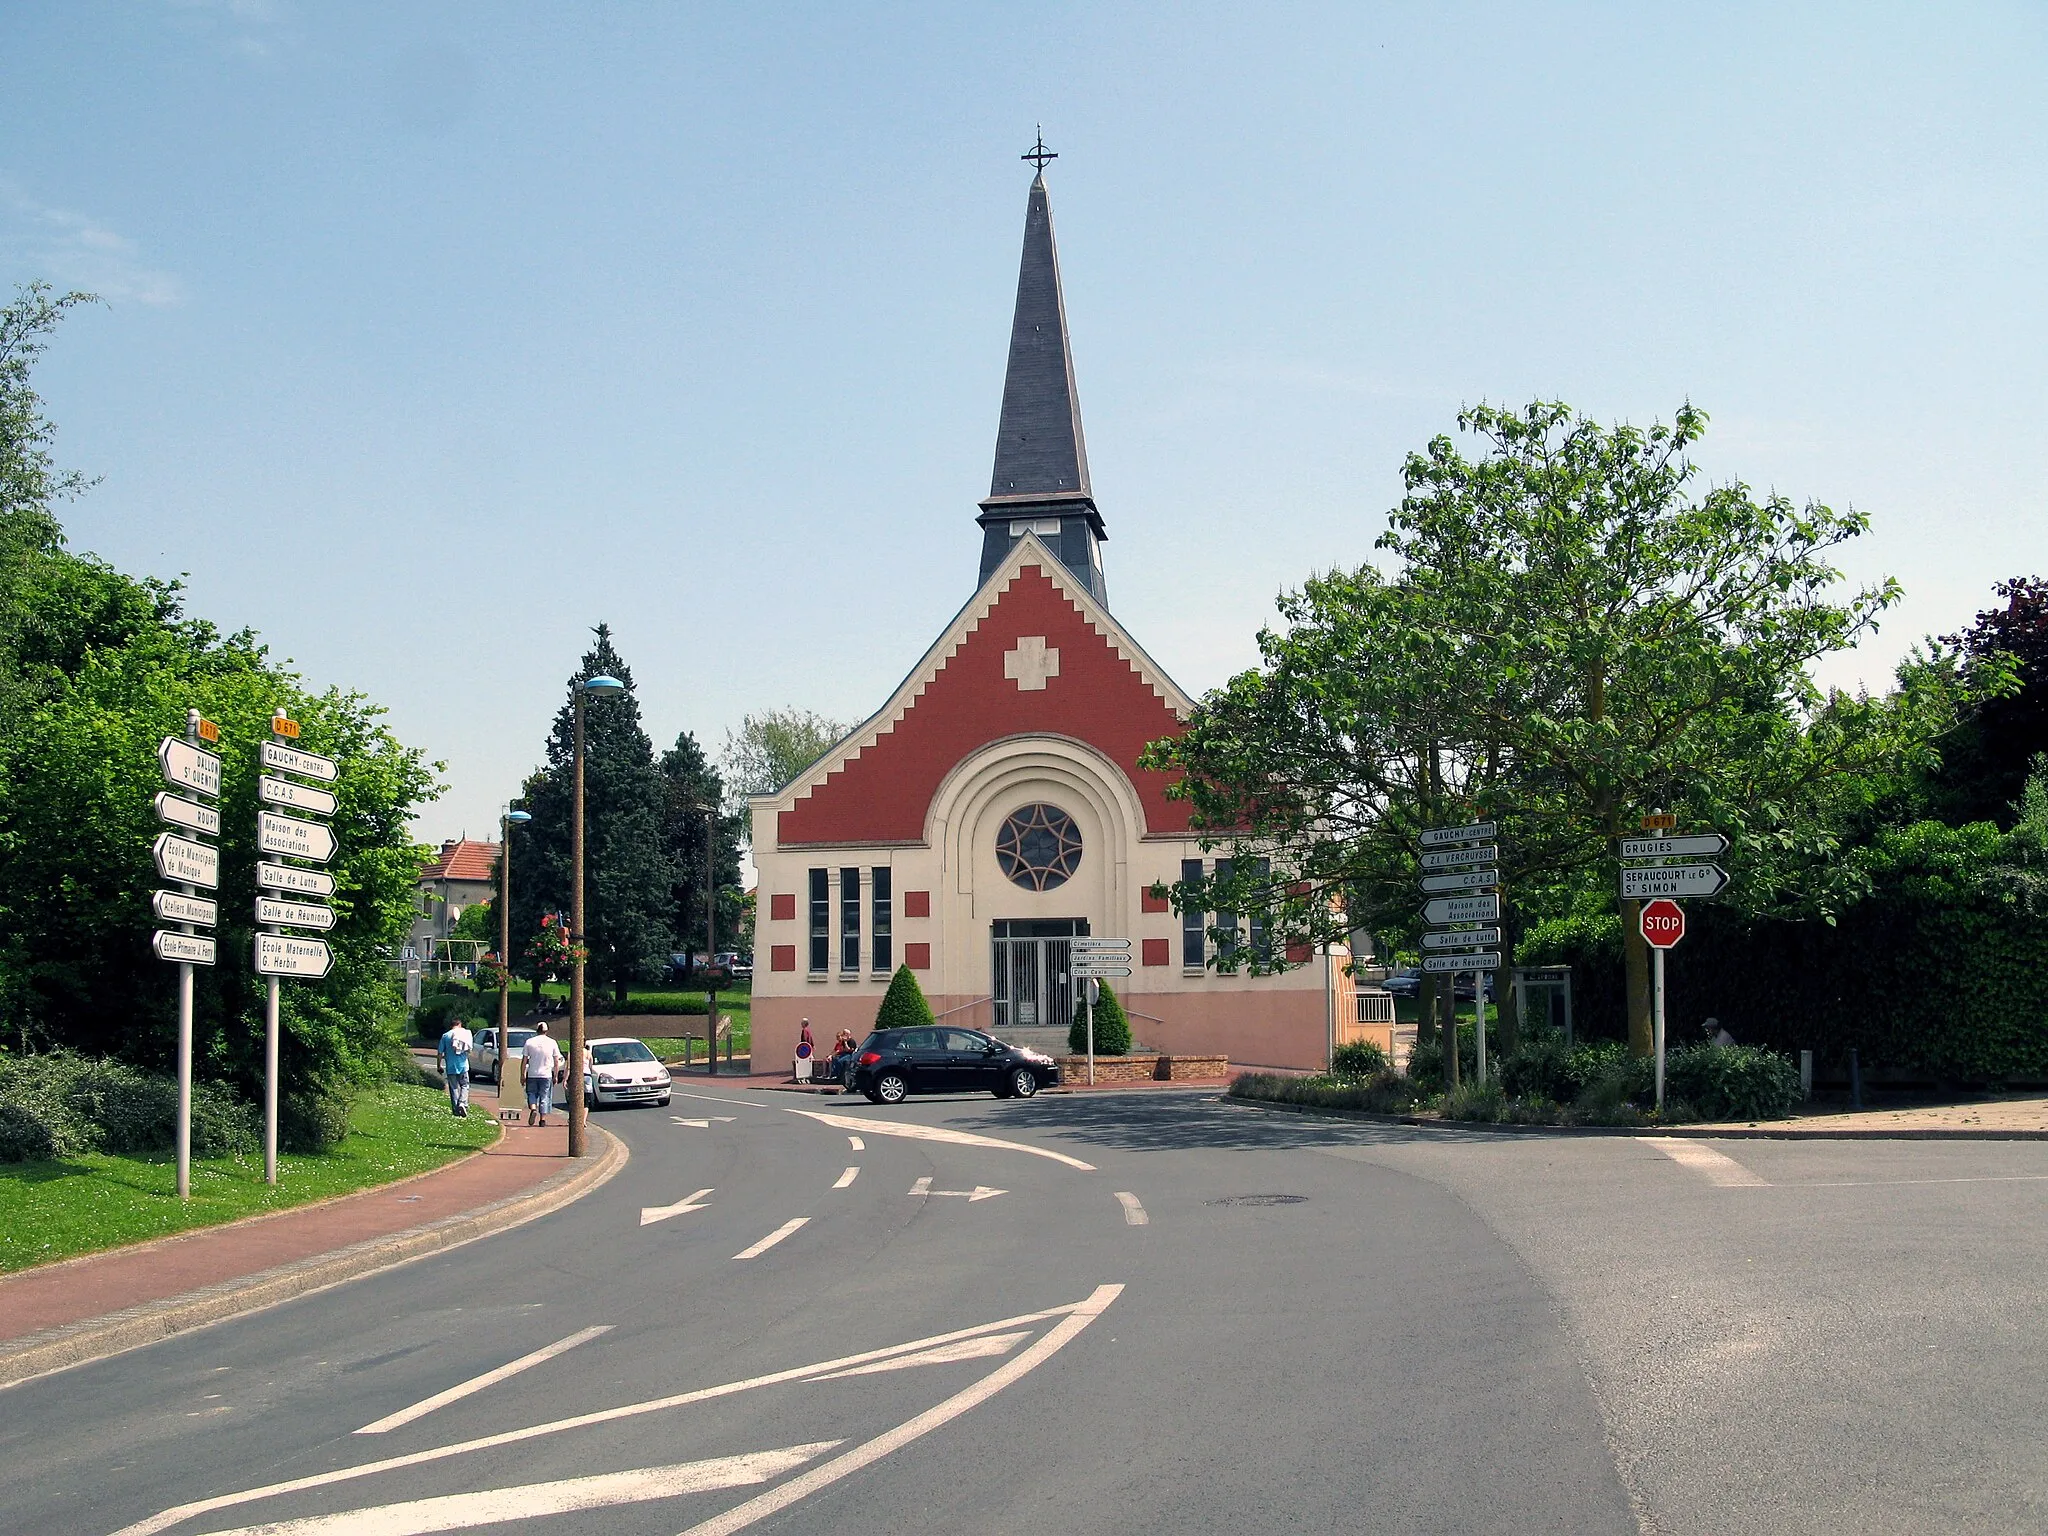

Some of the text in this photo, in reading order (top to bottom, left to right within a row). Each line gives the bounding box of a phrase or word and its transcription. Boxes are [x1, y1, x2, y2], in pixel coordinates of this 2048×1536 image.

[276, 720, 297, 735] D 671
[197, 756, 218, 774] DALLON
[192, 770, 218, 790] QUENTIN
[266, 784, 295, 800] C.C.A.S.
[198, 811, 217, 828] ROUPY
[1654, 817, 1672, 825] 671
[264, 818, 307, 838] Maison des
[264, 834, 310, 852] Associations
[1626, 842, 1672, 853] GRUGIES
[168, 840, 216, 866] École Municipale
[168, 858, 200, 878] de Musique
[1626, 870, 1686, 881] SERAUCOURT
[264, 870, 317, 888] Salle de Lutte
[1463, 875, 1492, 885] C.C.A.S.
[1642, 883, 1677, 892] SIMON
[164, 900, 214, 920] Ateliers Municipaux
[1448, 899, 1490, 910] Maison des
[263, 905, 328, 923] Salle de Réunions
[1448, 910, 1494, 920] Associations
[1646, 917, 1679, 930] STOP
[1440, 932, 1495, 944] Salle de Lutte
[178, 941, 196, 955] Primaire
[262, 938, 322, 957] École Maternelle
[262, 956, 297, 968] G. Herbin
[1428, 955, 1496, 969] Salle de Réunions
